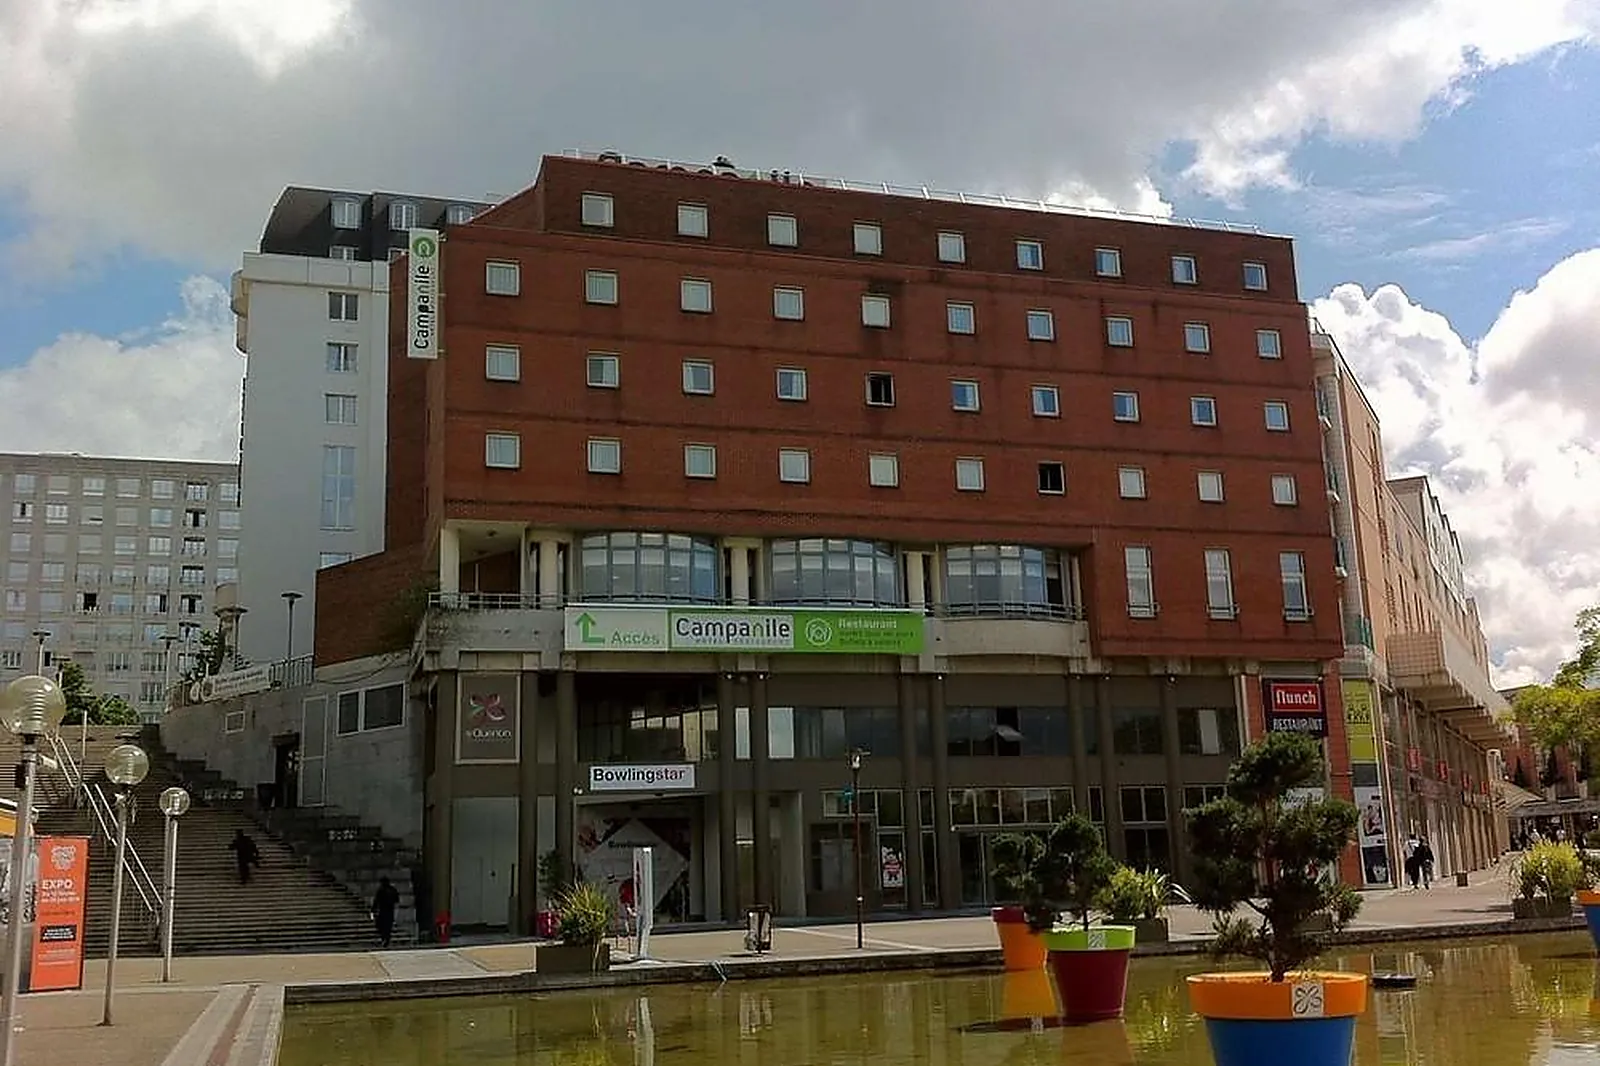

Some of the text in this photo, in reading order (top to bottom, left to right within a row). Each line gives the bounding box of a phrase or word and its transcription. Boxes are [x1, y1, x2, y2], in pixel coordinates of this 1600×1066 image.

[414, 265, 435, 349] Campanile
[676, 617, 790, 644] Campanile
[593, 767, 686, 783] Bowlingstar
[42, 879, 73, 890] EXPO
